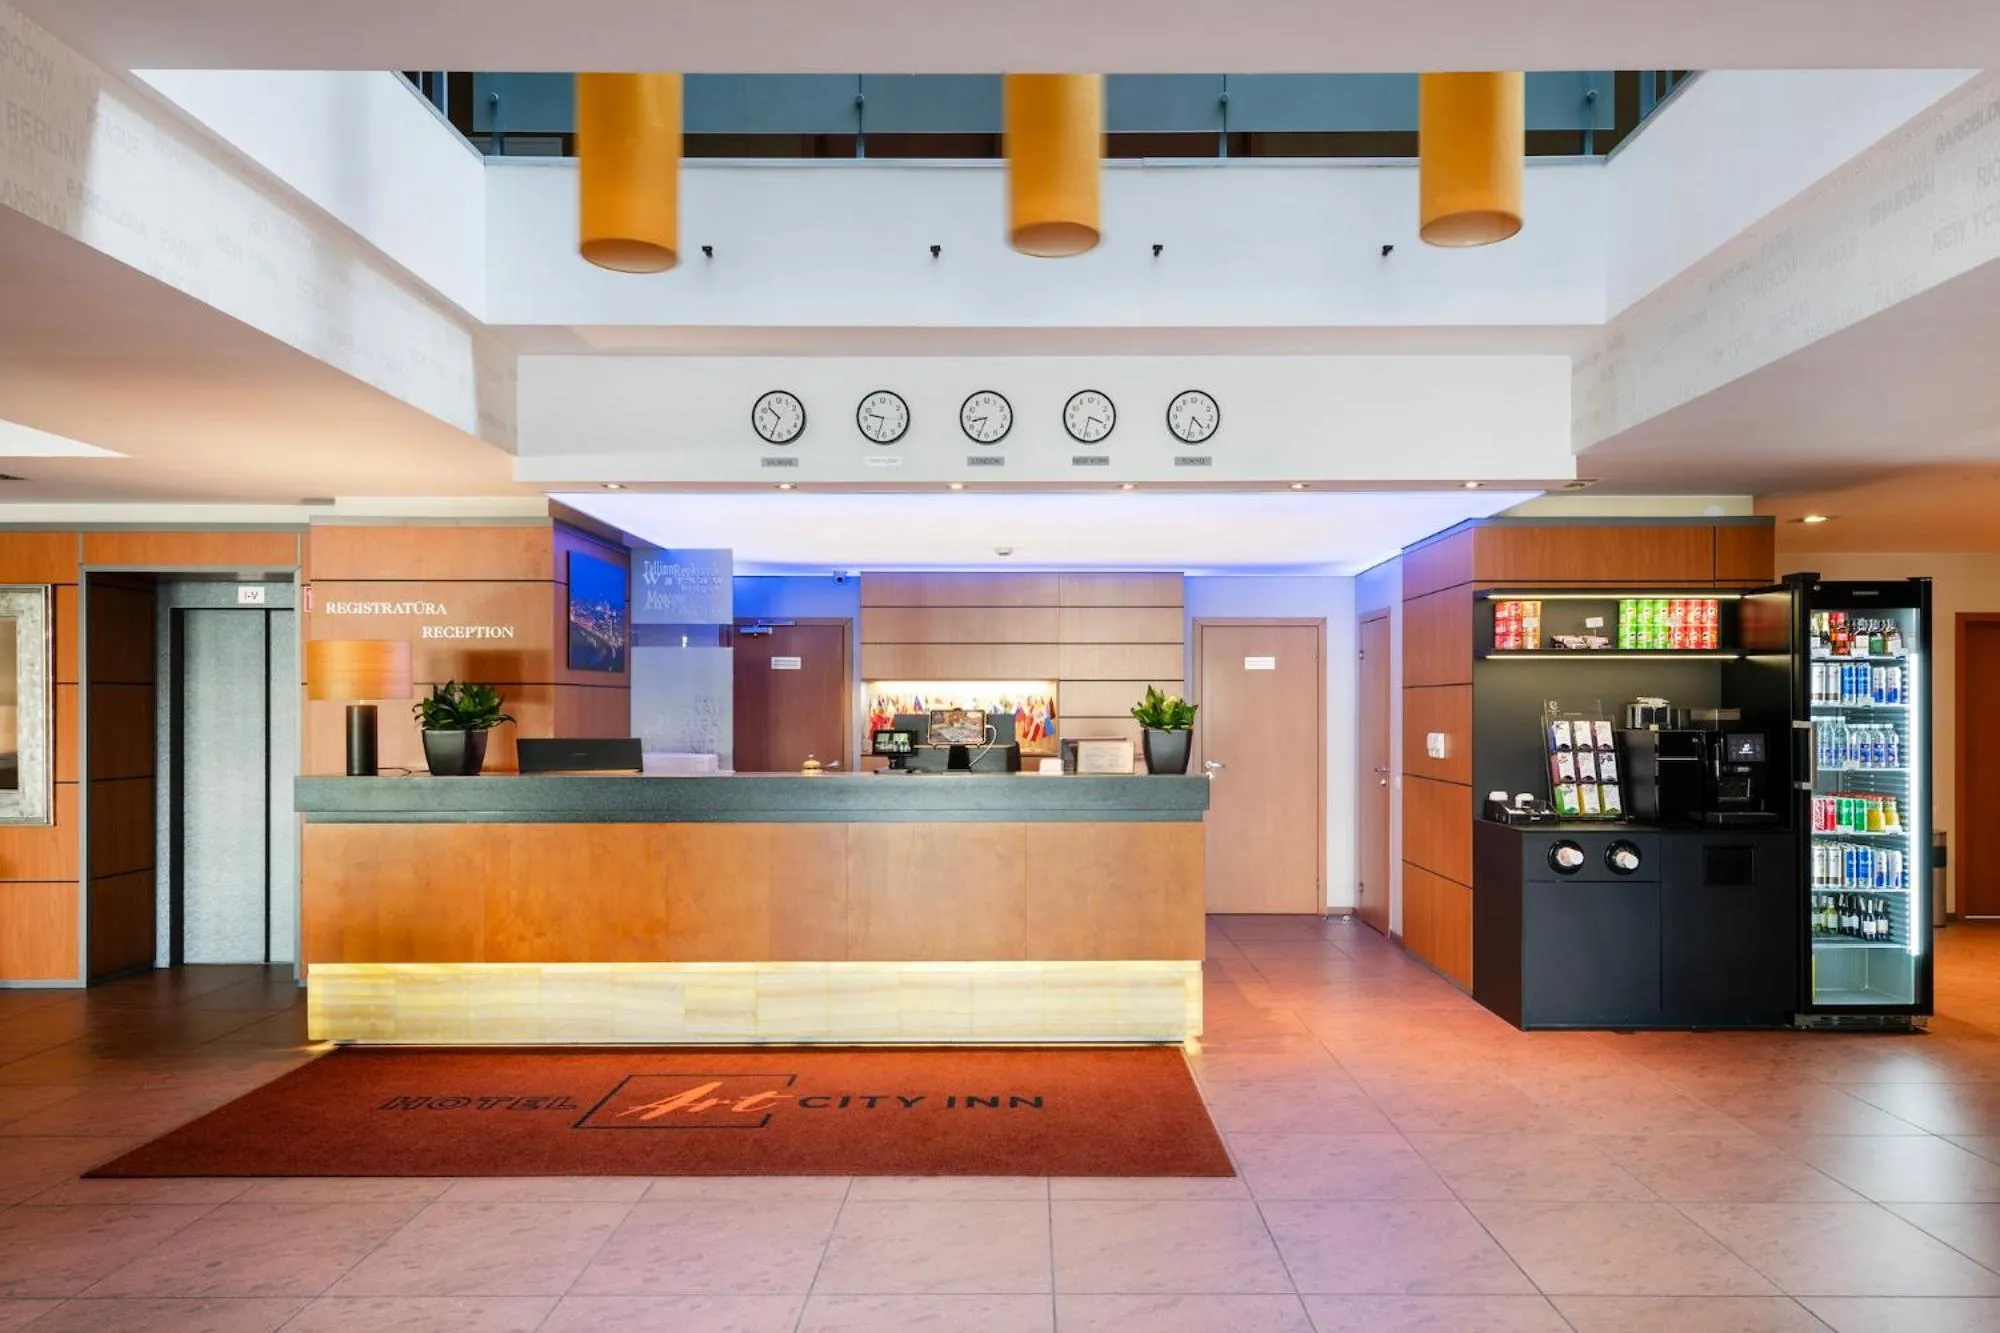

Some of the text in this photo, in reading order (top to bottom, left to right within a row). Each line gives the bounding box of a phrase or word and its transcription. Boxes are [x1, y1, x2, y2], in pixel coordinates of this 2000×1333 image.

[6, 102, 78, 170] BERLIN
[325, 600, 447, 615] REGISTRATŪRA
[421, 625, 515, 638] RECEPTION
[378, 1081, 1044, 1121] HOTEL Art CITY INN
